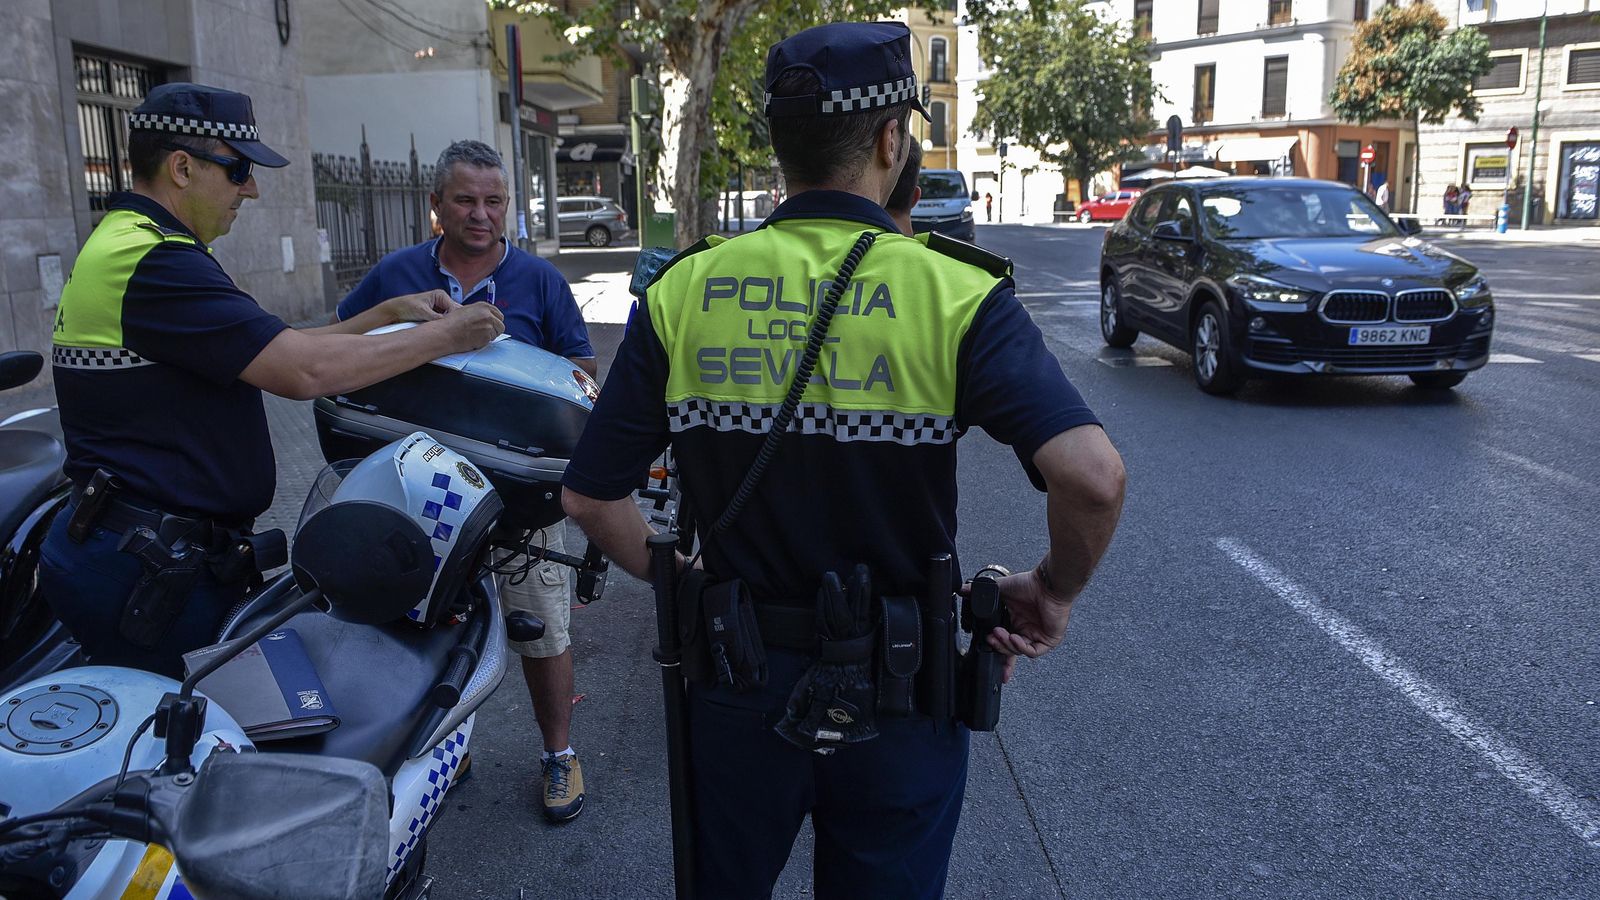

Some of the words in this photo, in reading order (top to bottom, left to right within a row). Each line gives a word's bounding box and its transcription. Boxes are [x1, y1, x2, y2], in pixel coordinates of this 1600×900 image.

[702, 276, 896, 318] POLICIA
[748, 318, 840, 343] LOC
[1360, 329, 1397, 343] 9862
[1400, 328, 1427, 342] KNC
